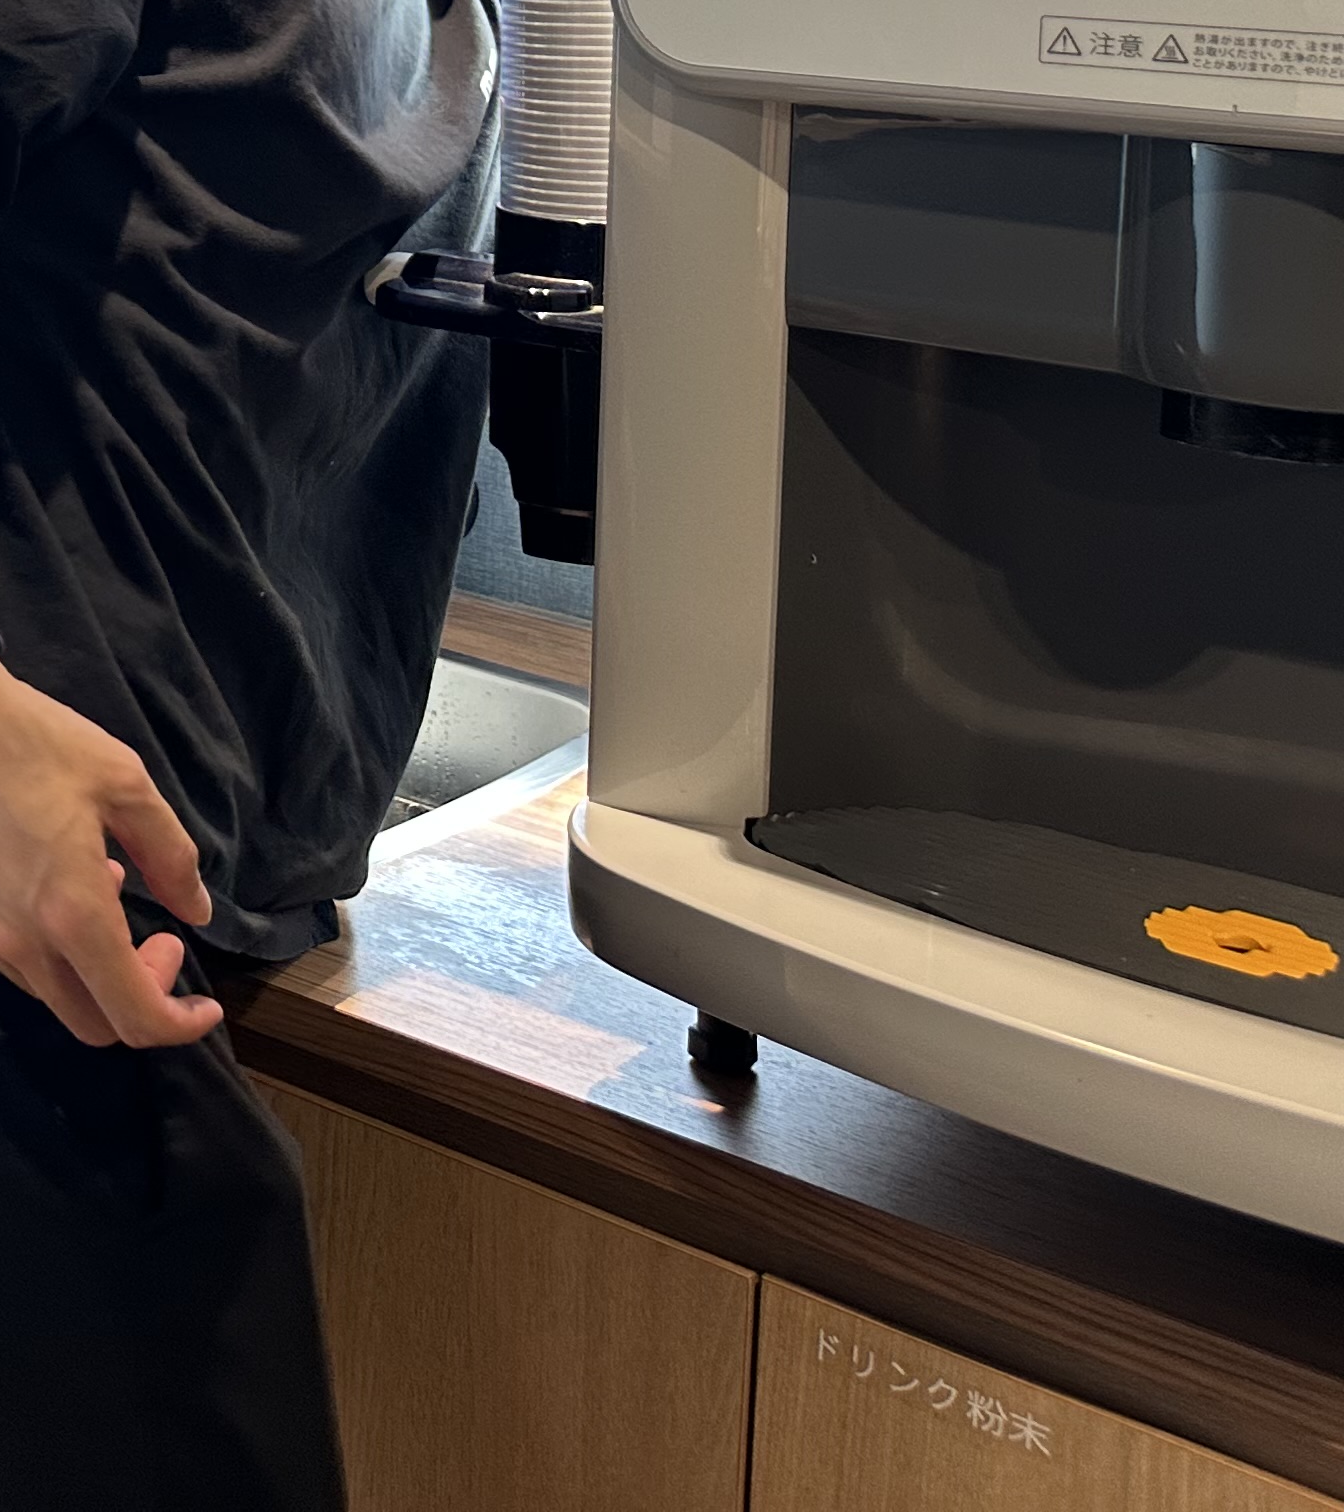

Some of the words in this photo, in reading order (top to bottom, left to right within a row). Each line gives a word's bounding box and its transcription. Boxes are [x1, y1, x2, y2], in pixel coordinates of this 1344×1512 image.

[1089, 31, 1143, 58] 注意
[817, 1329, 1052, 1457] ドリンク粉末
